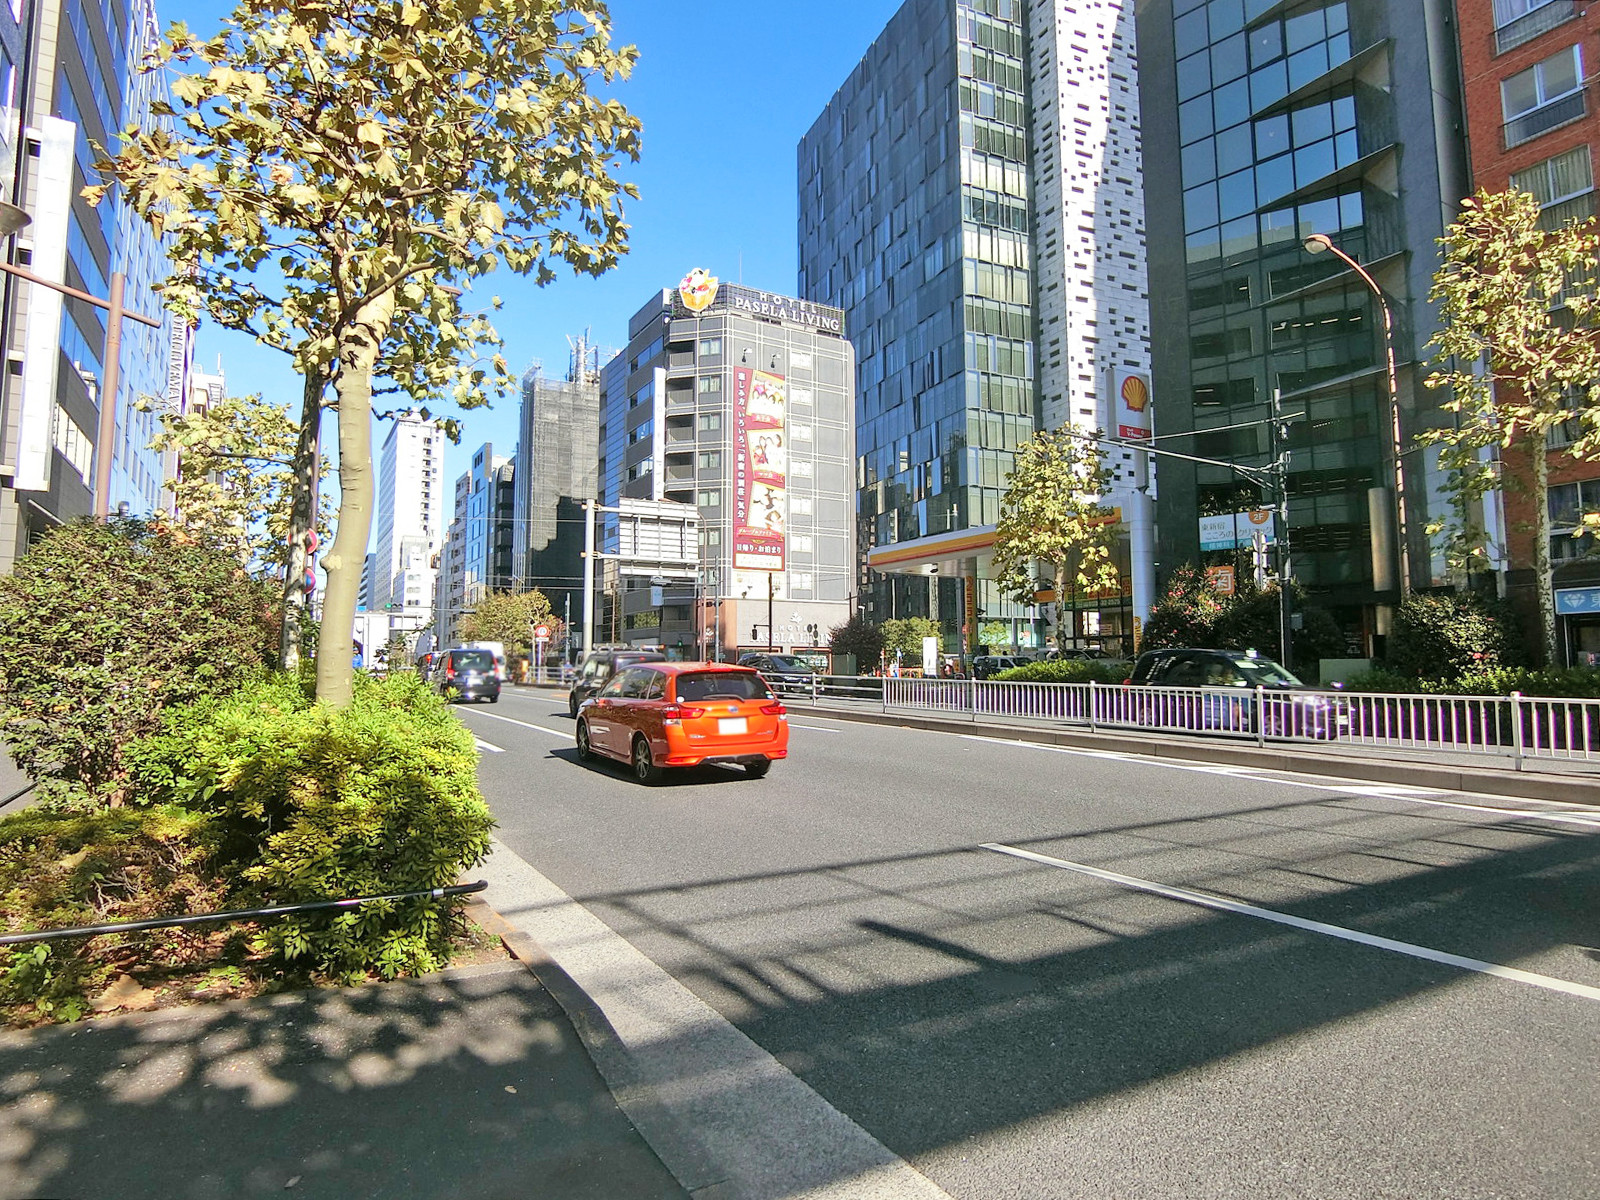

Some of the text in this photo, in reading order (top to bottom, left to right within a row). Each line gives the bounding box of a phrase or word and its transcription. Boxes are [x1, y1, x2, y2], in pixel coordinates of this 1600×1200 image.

[759, 291, 818, 314] HOTEL
[734, 297, 841, 331] PASELA LIVING
[1253, 513, 1265, 521] 2F
[1201, 521, 1226, 531] 東新宿
